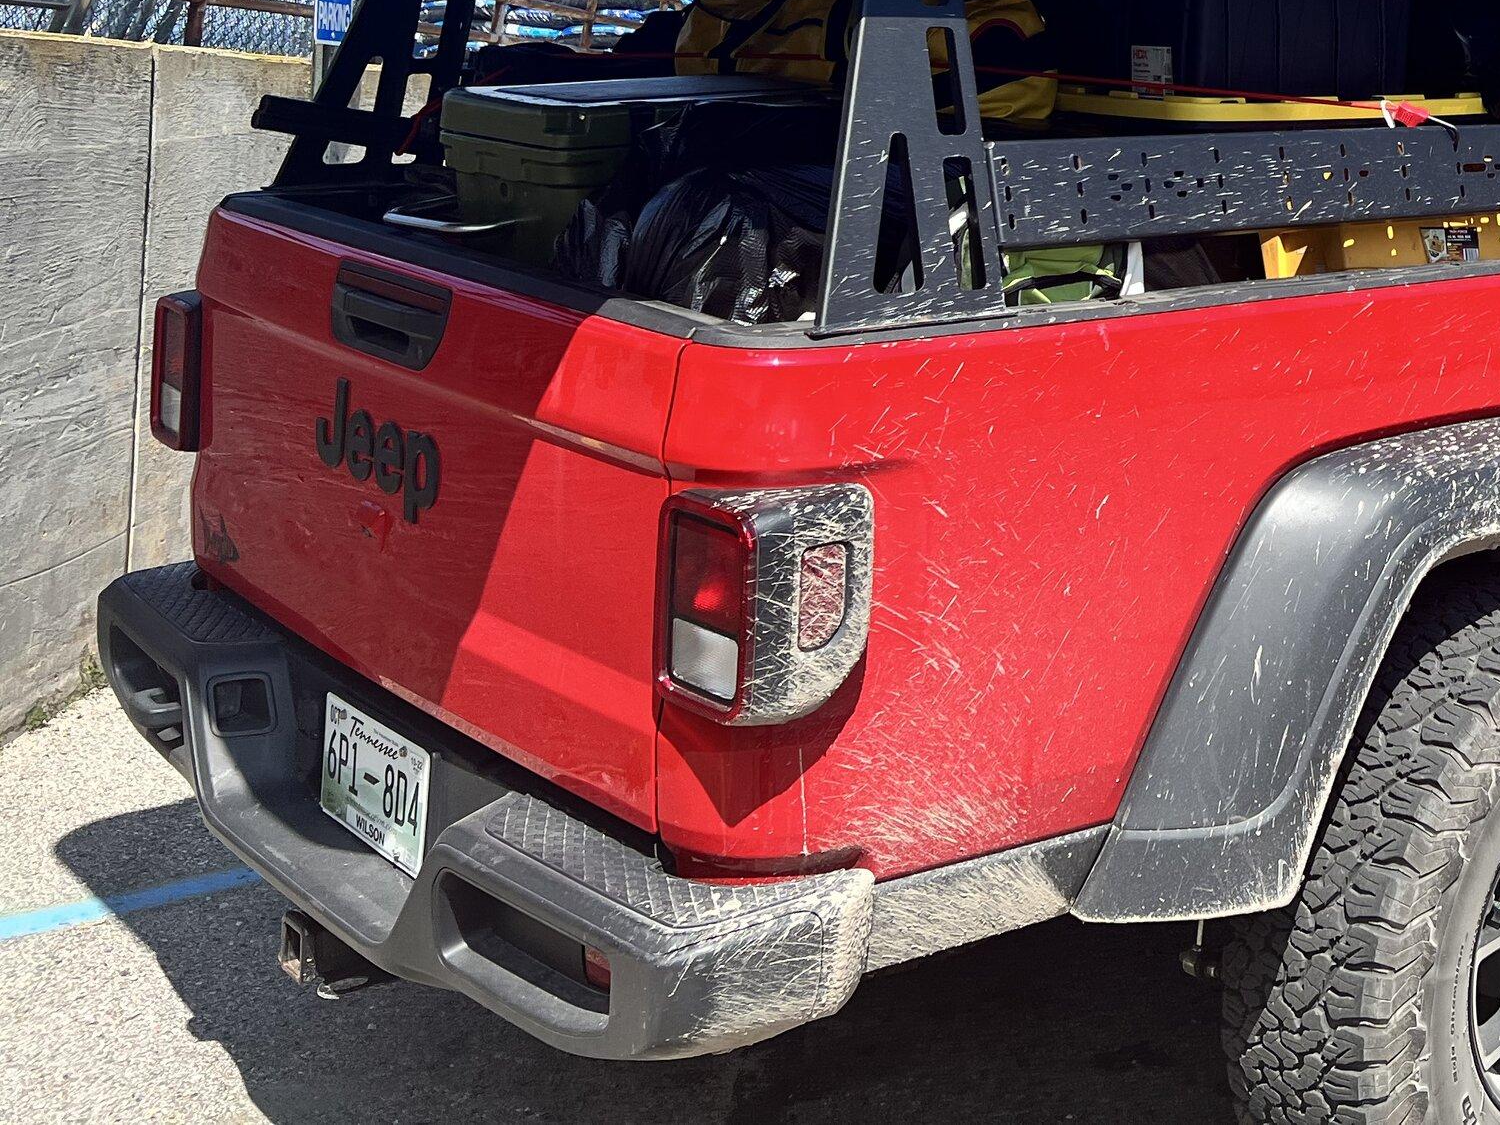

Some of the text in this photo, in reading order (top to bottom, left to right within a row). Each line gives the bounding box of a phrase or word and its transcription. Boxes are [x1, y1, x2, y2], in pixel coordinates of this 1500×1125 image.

[317, 0, 350, 34] PARKING
[315, 376, 440, 524] Jeep
[350, 716, 399, 761] Tennessee
[327, 729, 421, 837] 6P1-8D4
[356, 814, 386, 847] WILSON
